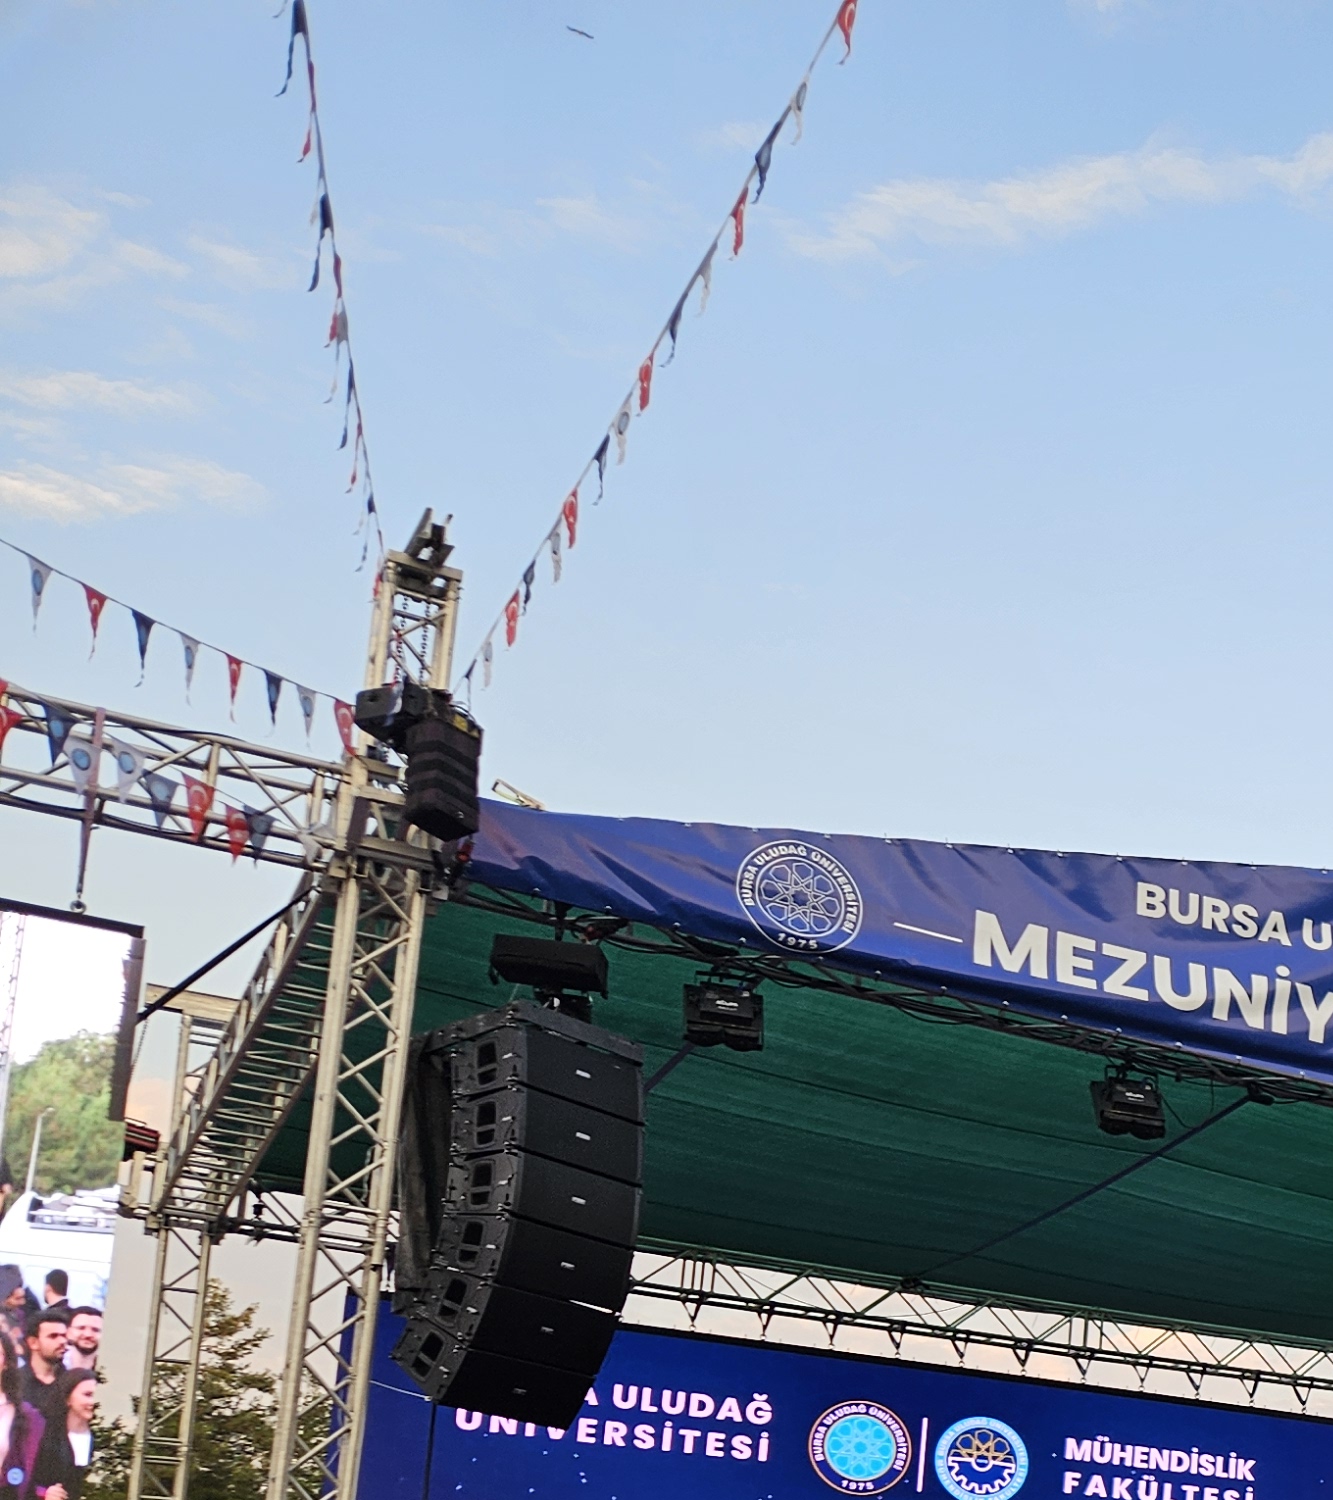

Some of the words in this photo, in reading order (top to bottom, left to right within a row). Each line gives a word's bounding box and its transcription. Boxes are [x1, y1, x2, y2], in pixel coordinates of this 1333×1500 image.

[740, 864, 759, 906] BURSA
[753, 844, 808, 866] ULUDAĞ
[1136, 881, 1292, 946] BURSA
[778, 933, 818, 949] 1975
[612, 1383, 773, 1425] ULUDAĞ
[1064, 1435, 1256, 1482] MÜHENDİSLİK
[841, 1479, 875, 1491] 1975
